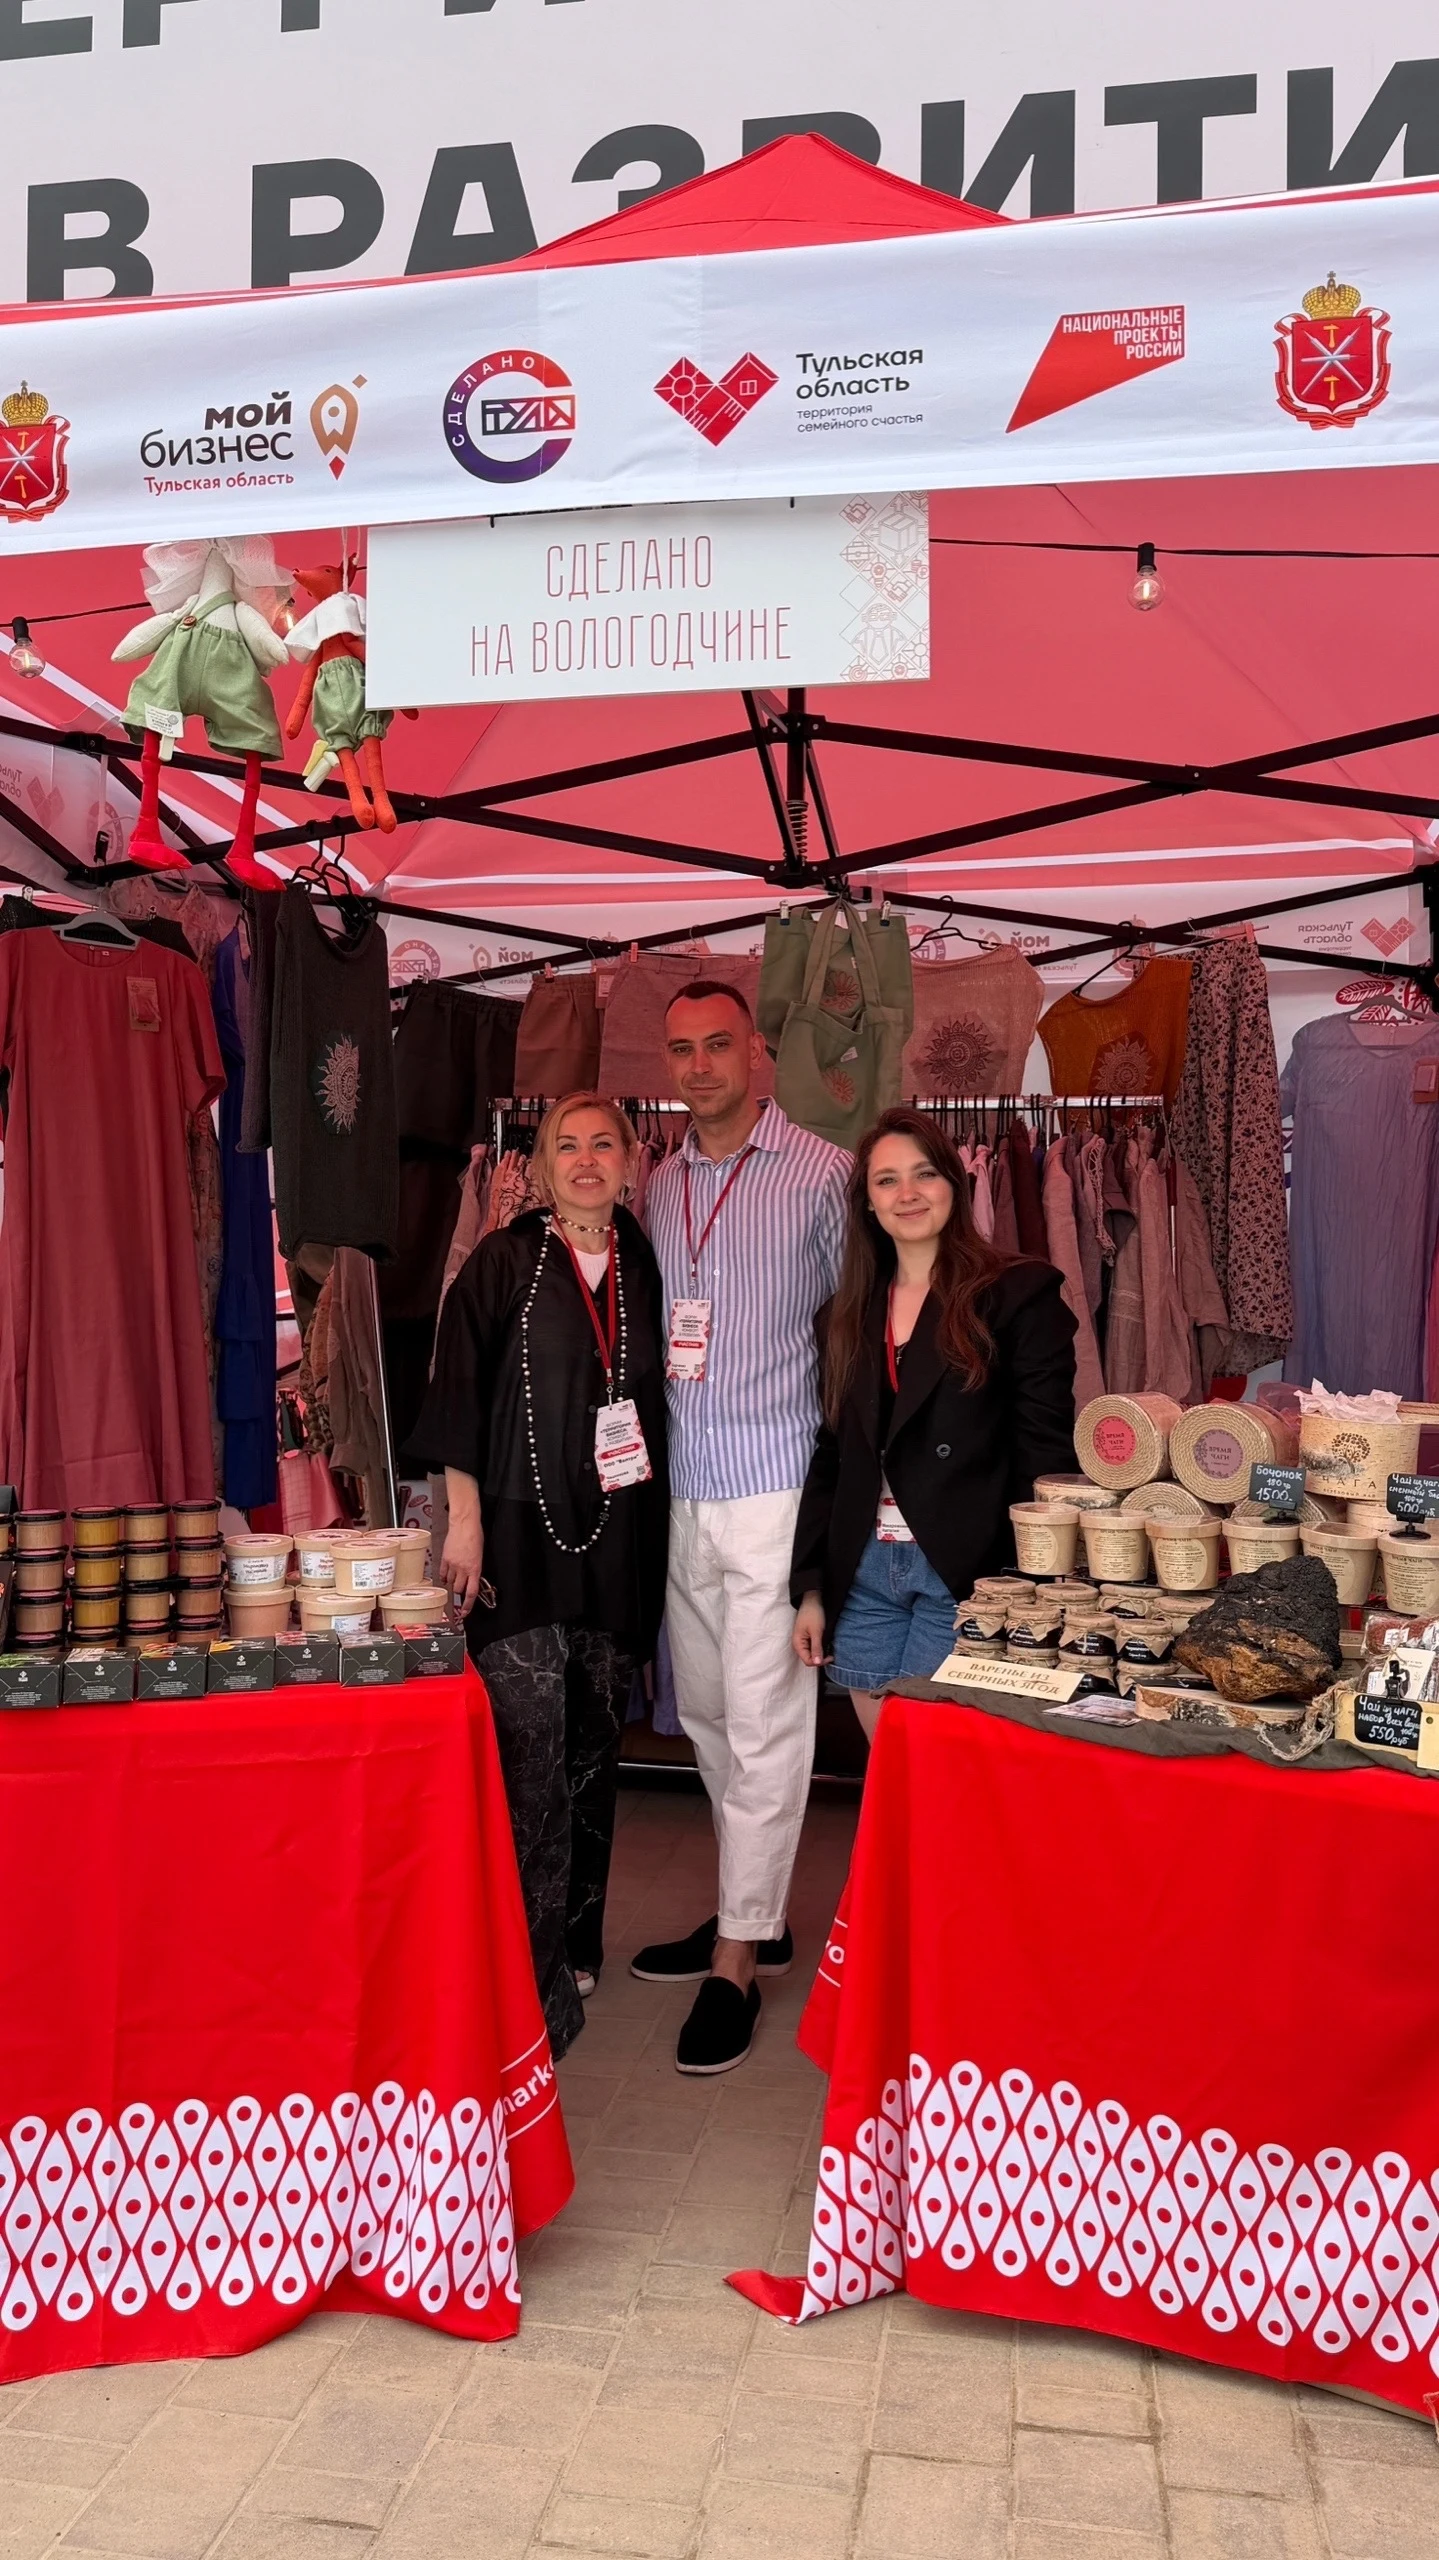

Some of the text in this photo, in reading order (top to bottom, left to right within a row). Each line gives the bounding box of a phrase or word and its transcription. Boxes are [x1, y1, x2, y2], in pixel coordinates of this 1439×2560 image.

[27, 179, 154, 303] В
[1062, 308, 1182, 334] НАЦИОНАЛЬНЫЕ
[1113, 325, 1182, 345] ПРОЕКТЫ
[1126, 340, 1182, 360] РОССИИ
[796, 349, 923, 377] Тульская
[796, 377, 910, 399] область
[204, 390, 292, 430] мой
[448, 355, 535, 447] СДЕЛАНО
[797, 404, 873, 420] территория
[797, 413, 923, 433] семейного счастья
[140, 428, 294, 468] бизнес
[143, 471, 294, 496] Тульская область
[546, 535, 711, 601] СДЕЛАНО
[472, 607, 791, 676] НА ВОЛОГОДЧИНЕ
[1267, 1478, 1282, 1486] 180
[1322, 1475, 1377, 1489] ЧАГА
[1392, 1473, 1412, 1485] Чай
[1397, 1501, 1419, 1513] 500
[970, 1663, 1050, 1681] ВАРЕНЬЕ ИЗ
[947, 1671, 1061, 1695] СЕВЕРНЫХ ЯГОД
[1359, 1696, 1381, 1712] Чай
[1368, 1725, 1395, 1741] 550
